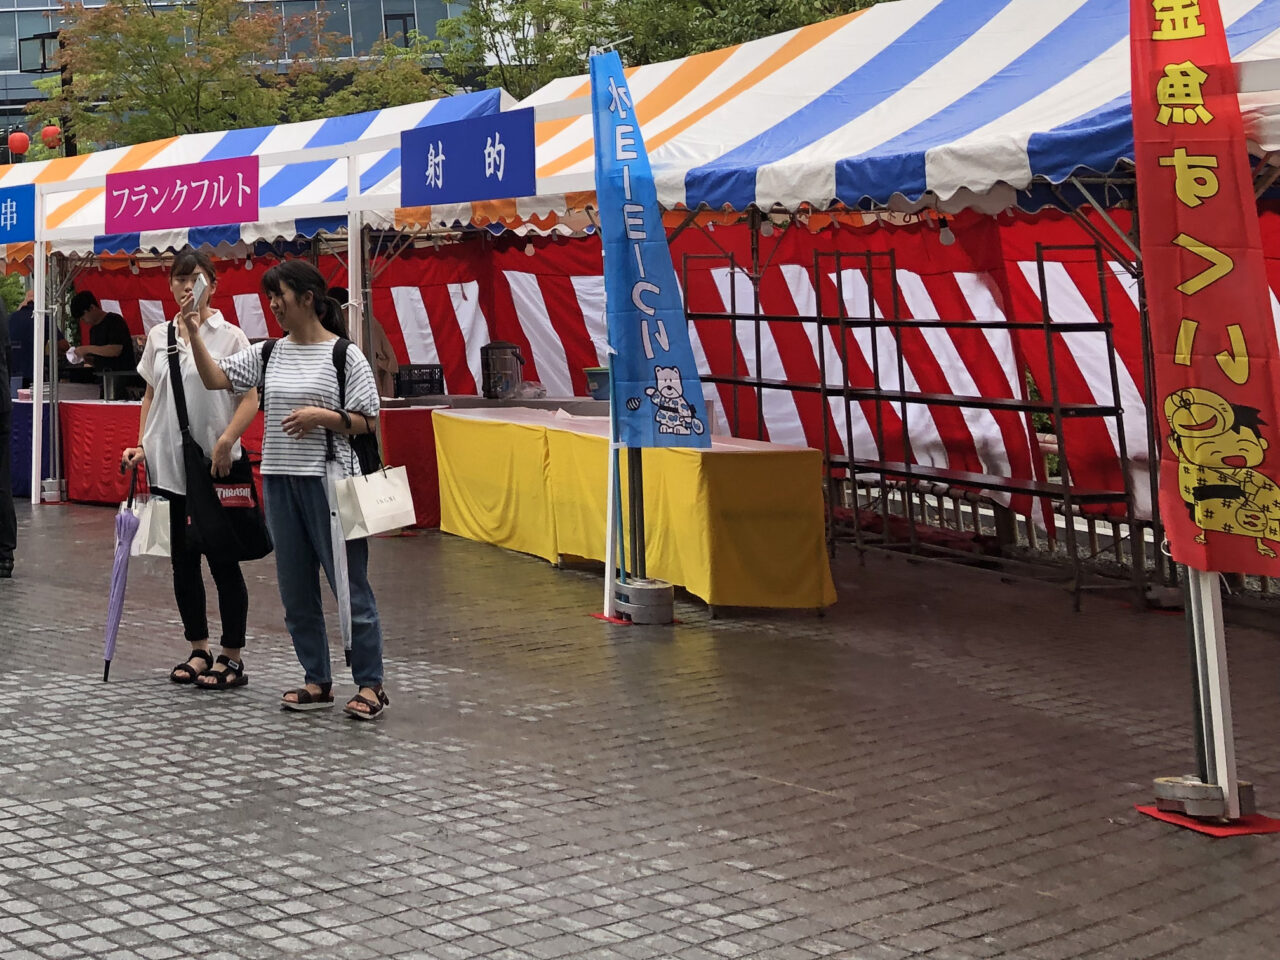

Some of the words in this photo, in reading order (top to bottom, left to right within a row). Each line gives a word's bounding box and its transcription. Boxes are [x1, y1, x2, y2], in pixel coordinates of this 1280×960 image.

[425, 132, 506, 189] 射的
[112, 172, 251, 219] フランクフルト
